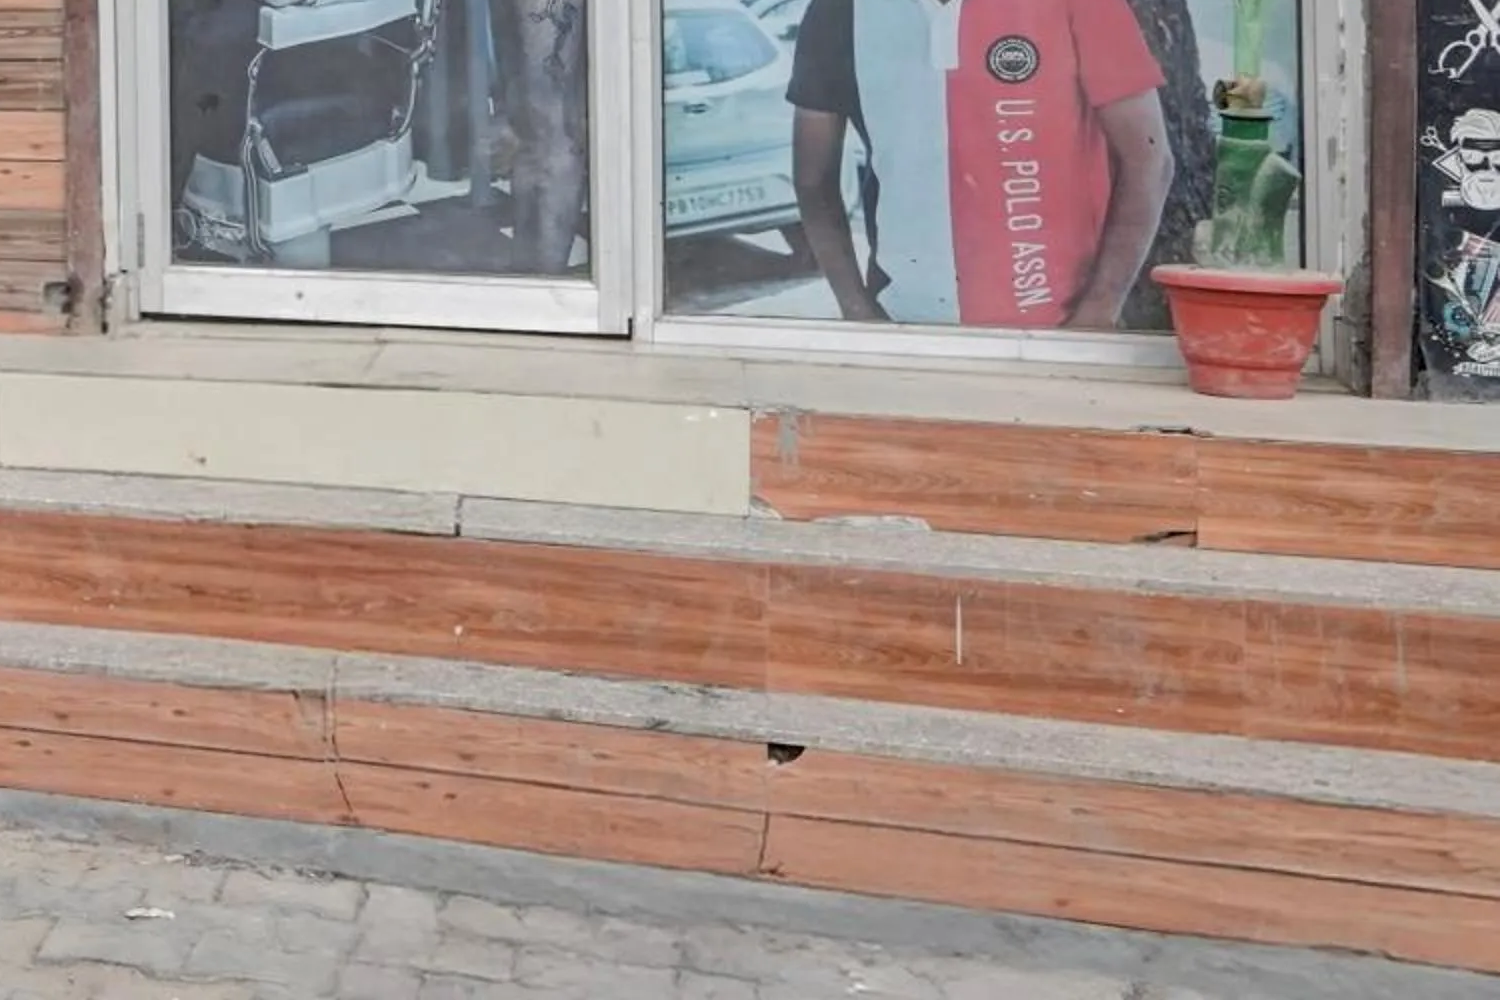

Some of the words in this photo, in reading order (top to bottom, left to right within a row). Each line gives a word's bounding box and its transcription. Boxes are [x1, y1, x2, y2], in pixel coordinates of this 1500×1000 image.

[995, 99, 1036, 152] U.S.
[1001, 159, 1043, 232] POLO
[1011, 241, 1054, 314] ASSN.
